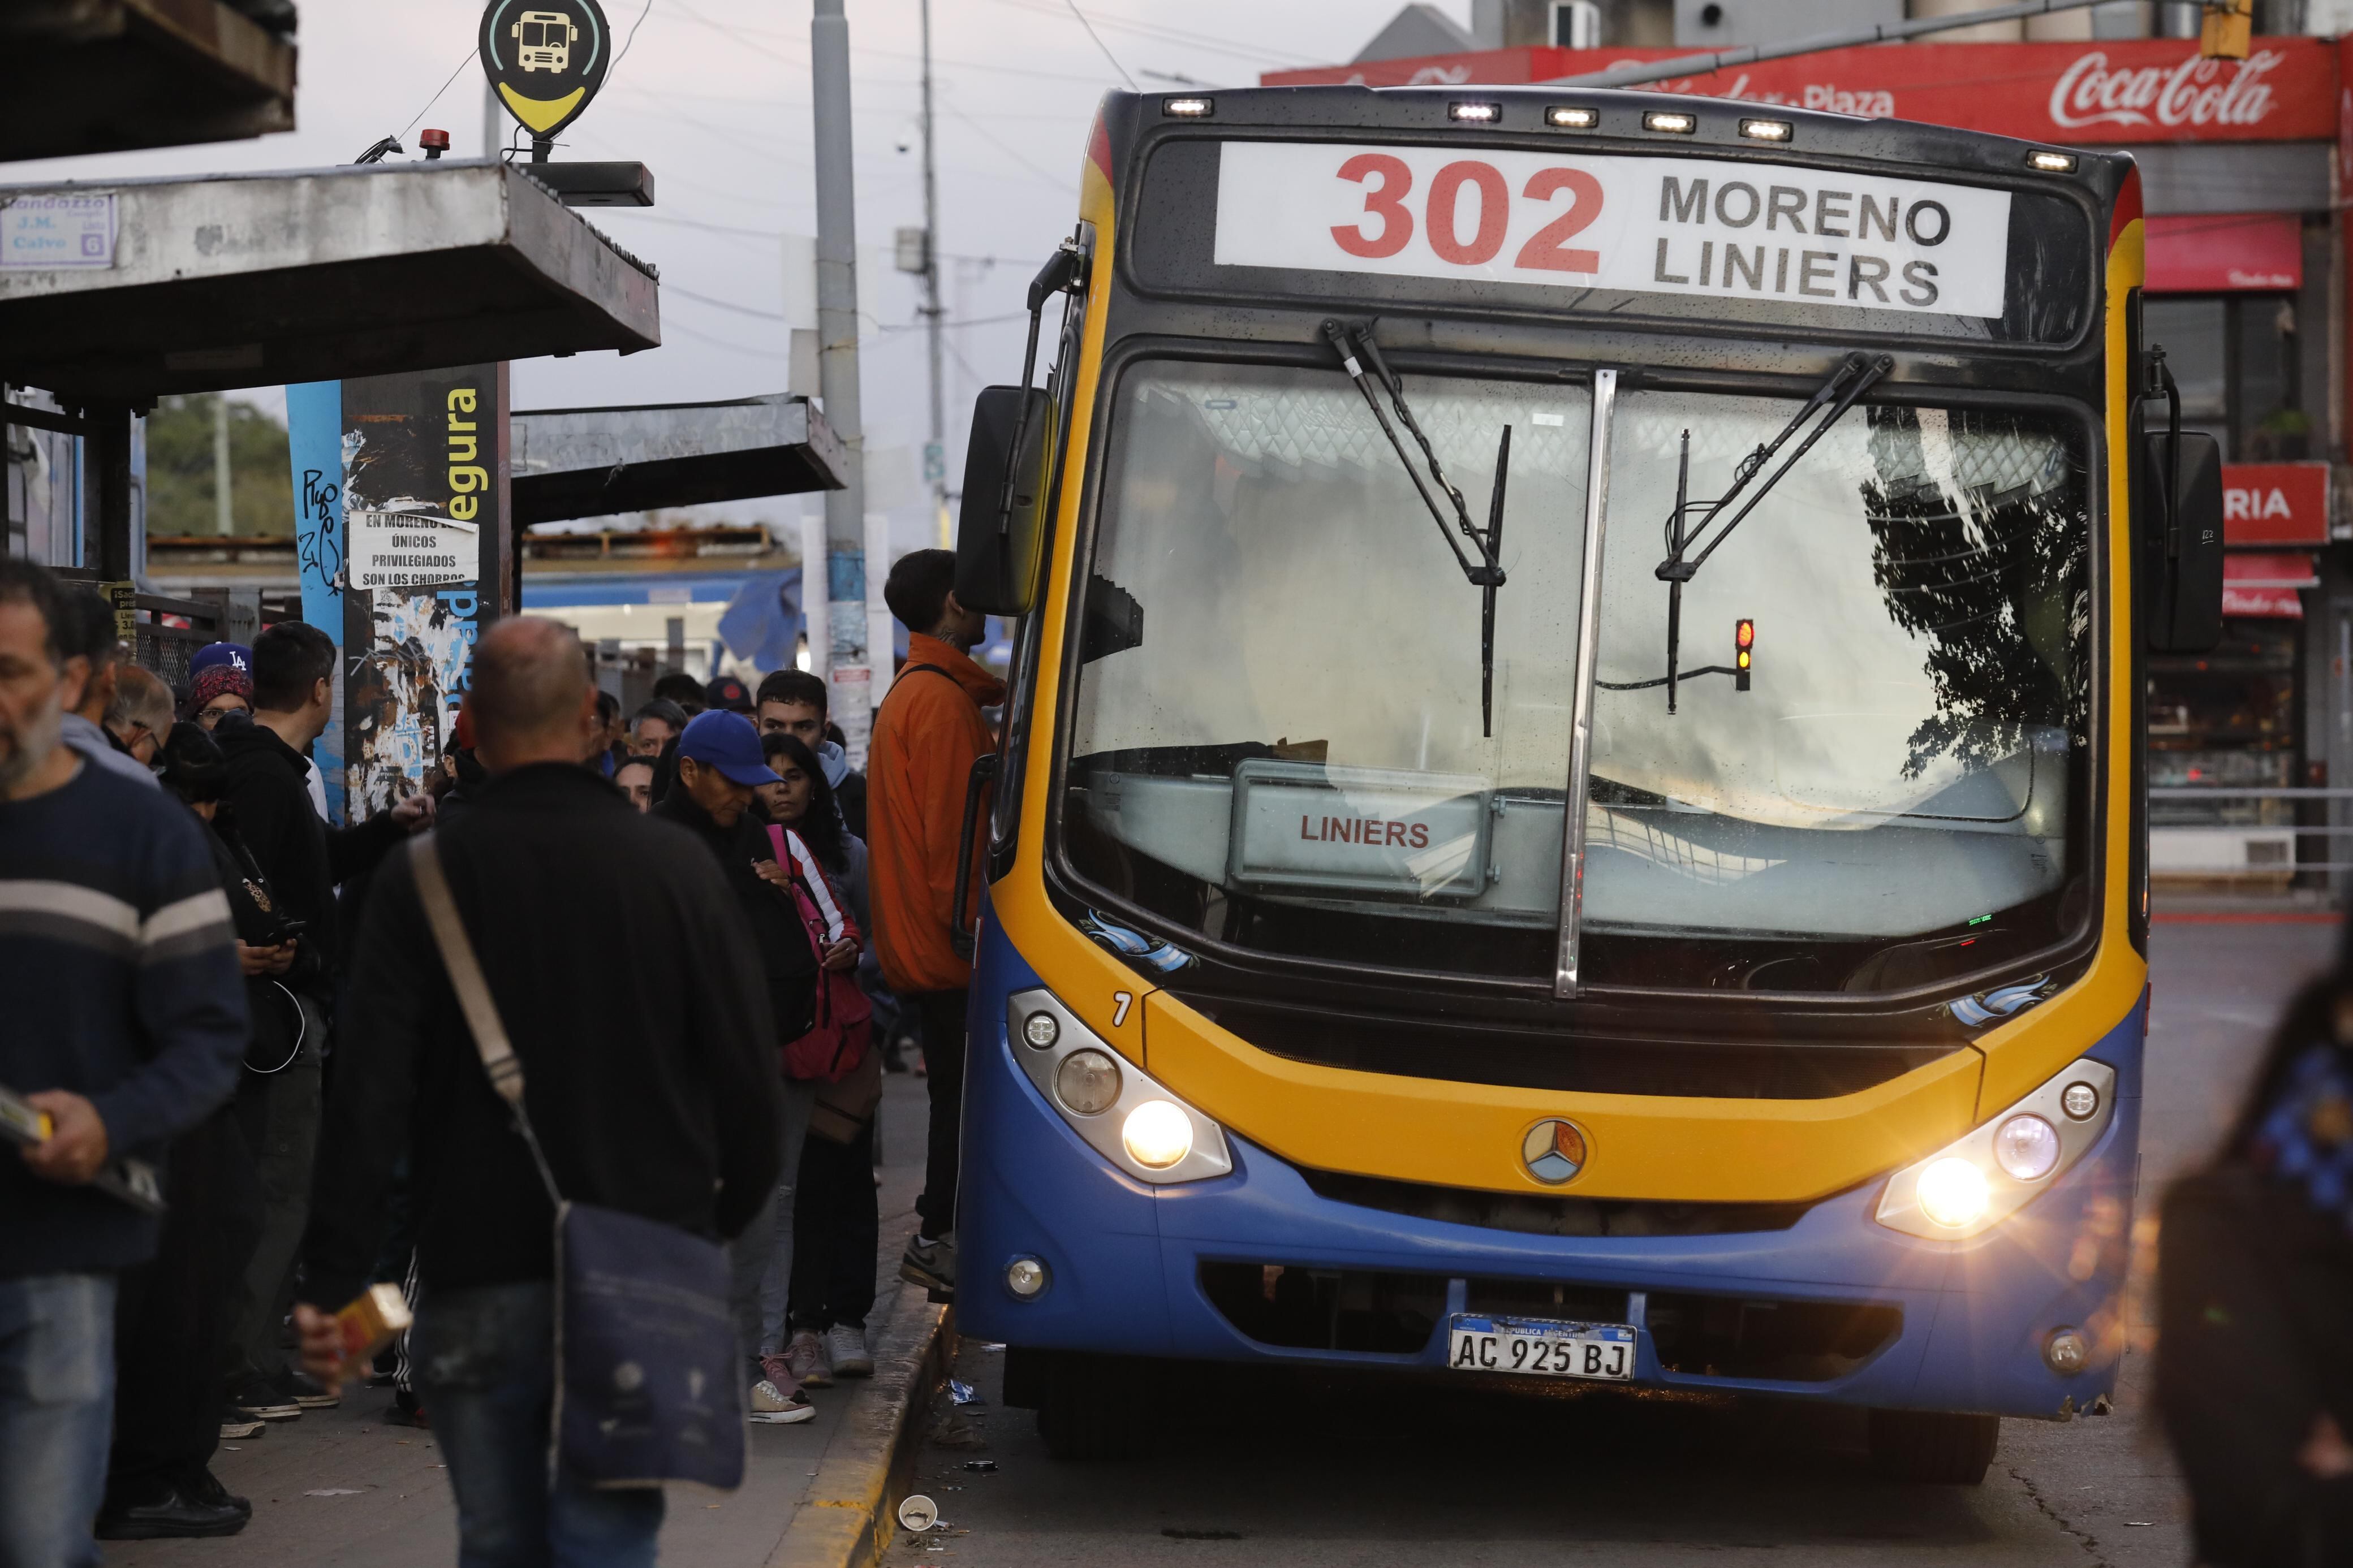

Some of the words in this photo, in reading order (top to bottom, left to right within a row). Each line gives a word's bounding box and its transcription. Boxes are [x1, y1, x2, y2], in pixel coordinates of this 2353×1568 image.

[2049, 50, 2285, 128] Coca-Cola
[1330, 153, 1604, 274] 302
[1659, 176, 1951, 247] MORENO
[1654, 237, 1939, 307] LINIERS
[448, 388, 489, 520] egura
[367, 515, 381, 528] EN
[392, 533, 436, 548] ÚNICOS
[363, 573, 385, 585] SON
[388, 573, 408, 585] LOS
[372, 555, 456, 567] PRIVILEGIADOS
[230, 651, 247, 671] LA
[1301, 815, 1429, 849] LINIERS
[1113, 990, 1132, 1028] 7
[1459, 1335, 1497, 1367] AC
[1512, 1338, 1571, 1372] 925
[1584, 1344, 1625, 1376] BJ
